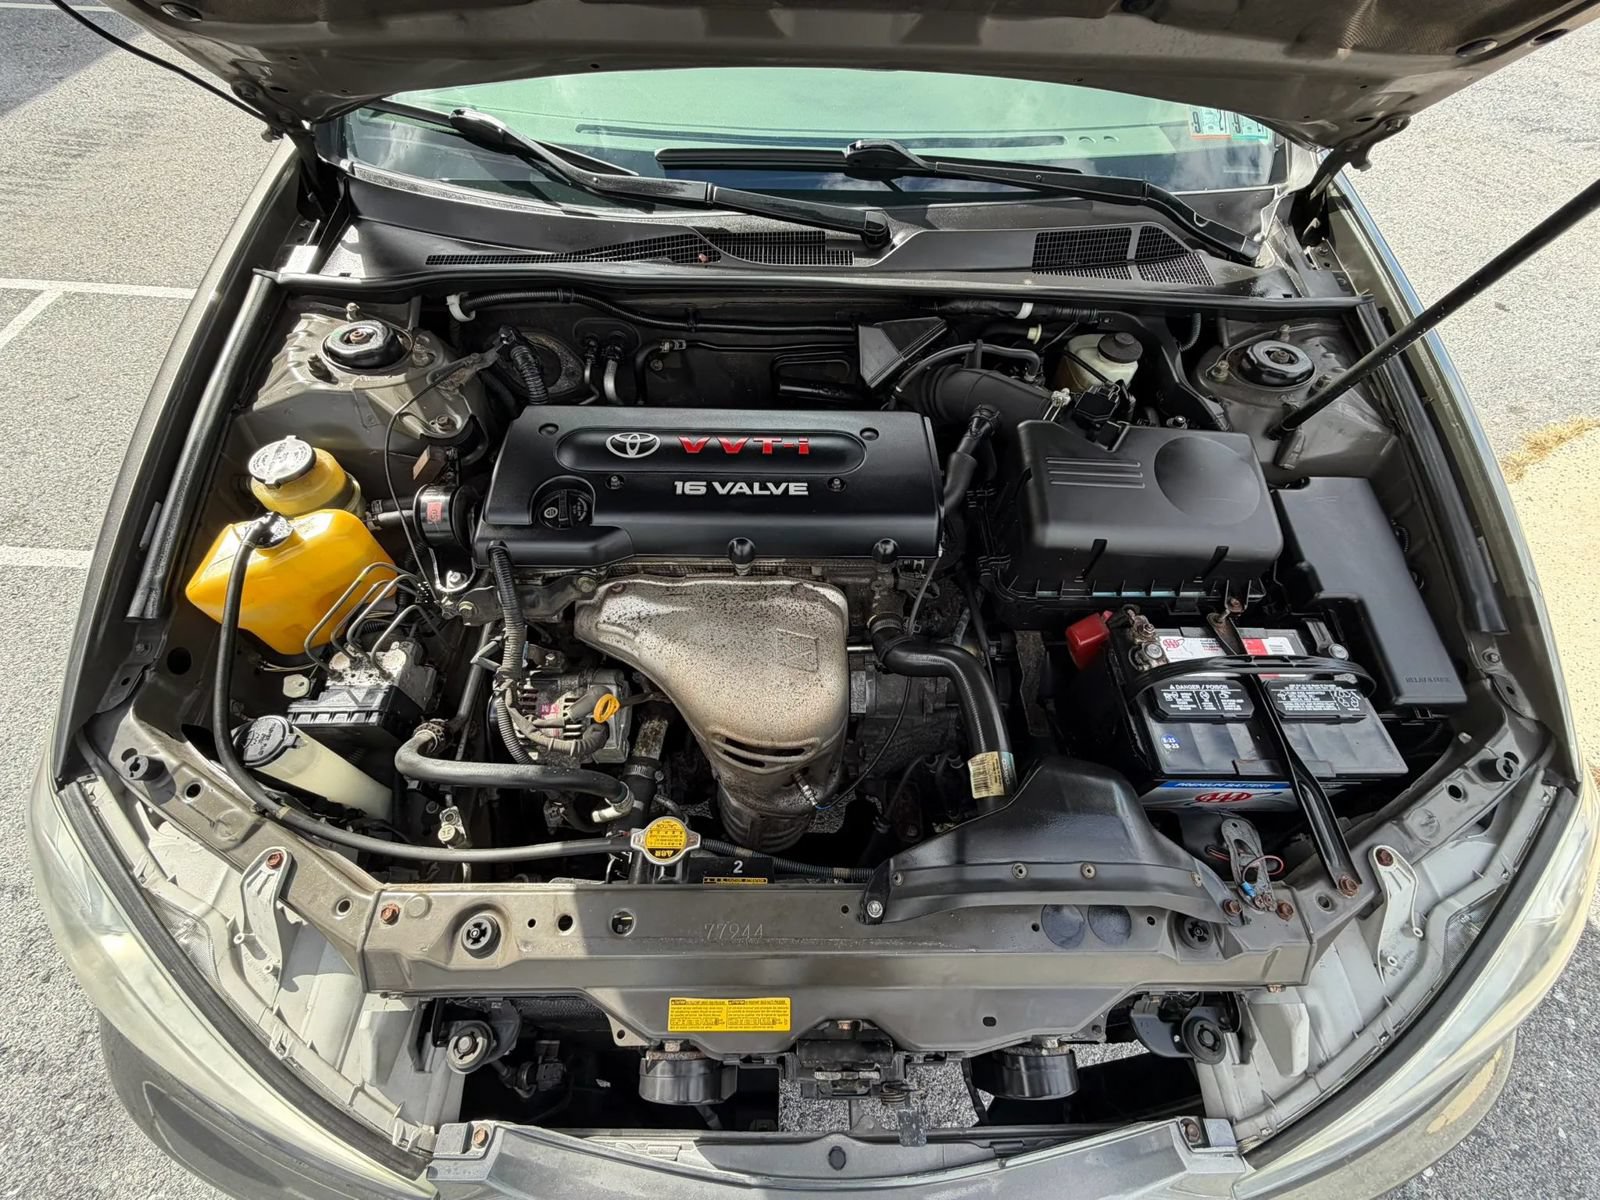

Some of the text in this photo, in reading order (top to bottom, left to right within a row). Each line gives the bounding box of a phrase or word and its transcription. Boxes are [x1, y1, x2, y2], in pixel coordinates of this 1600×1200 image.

[673, 480, 809, 496] 16 VALVE
[732, 859, 744, 874] 2
